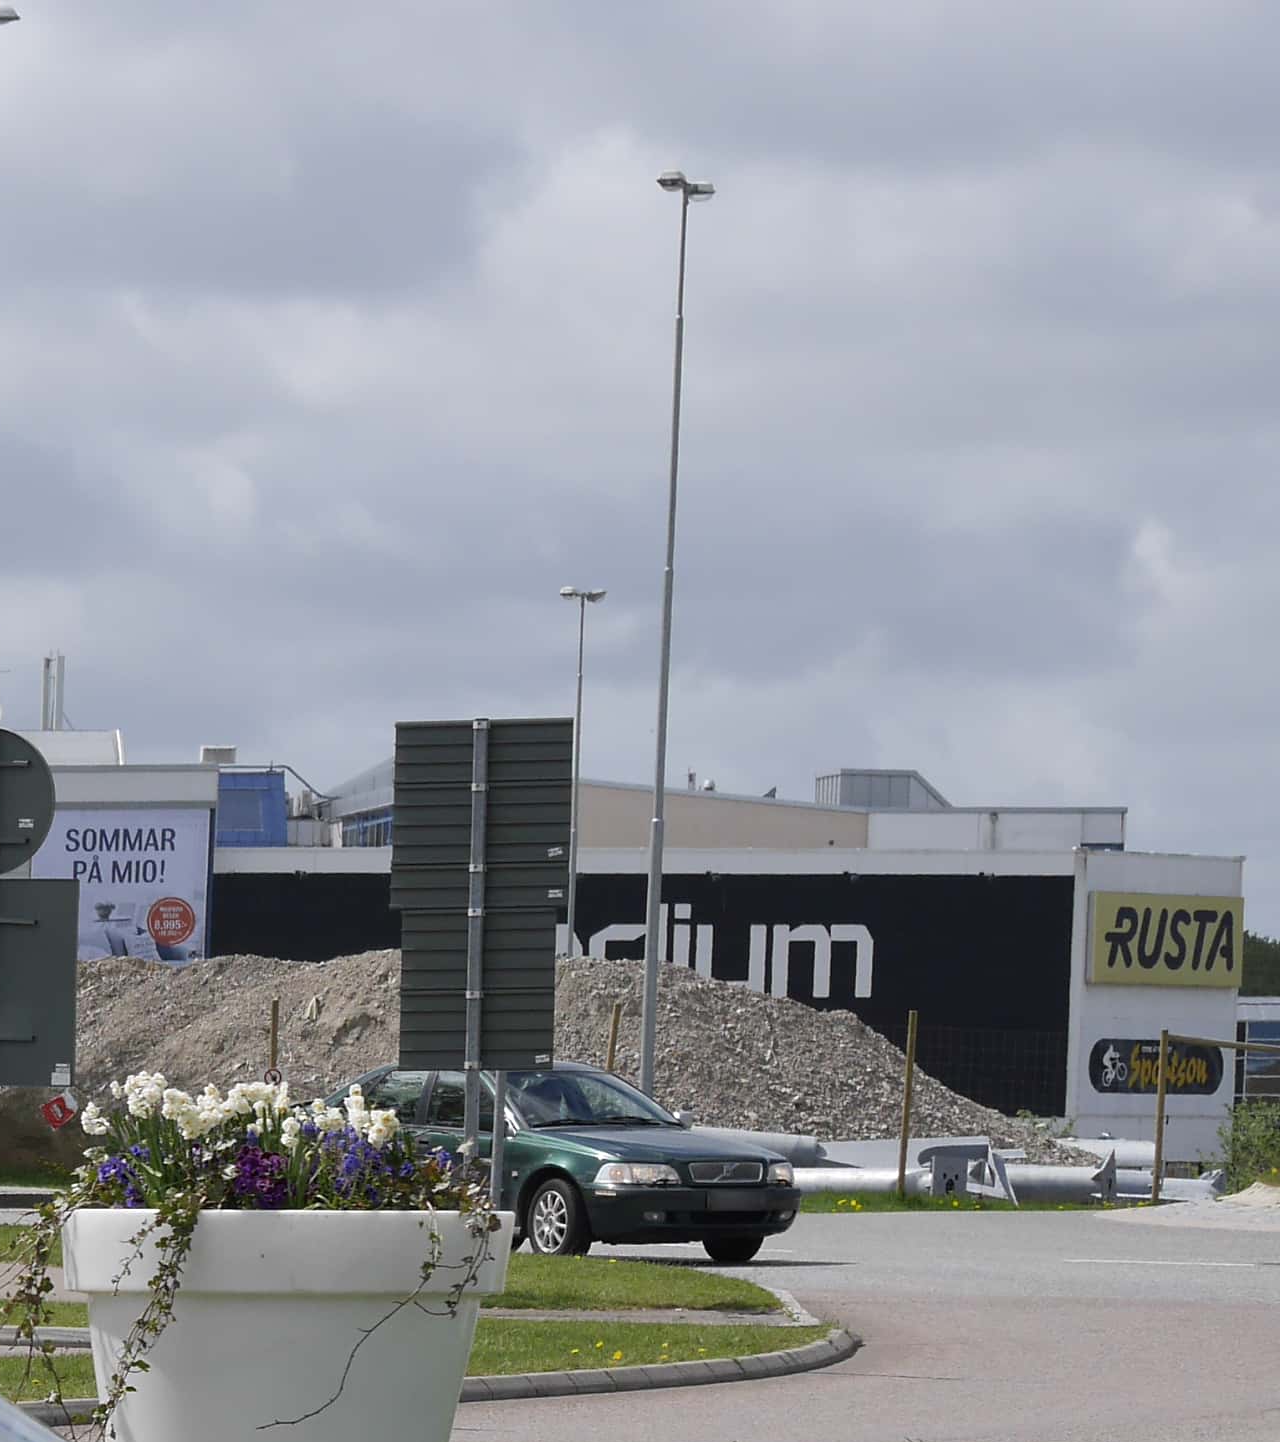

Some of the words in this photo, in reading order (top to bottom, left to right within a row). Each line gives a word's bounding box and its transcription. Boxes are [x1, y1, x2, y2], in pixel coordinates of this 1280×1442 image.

[65, 828, 176, 852] SOMMAR
[73, 855, 102, 883] PÅ
[111, 860, 165, 883] MIO!
[1105, 906, 1234, 971] RUSTA
[1128, 1043, 1209, 1089] Spotson
